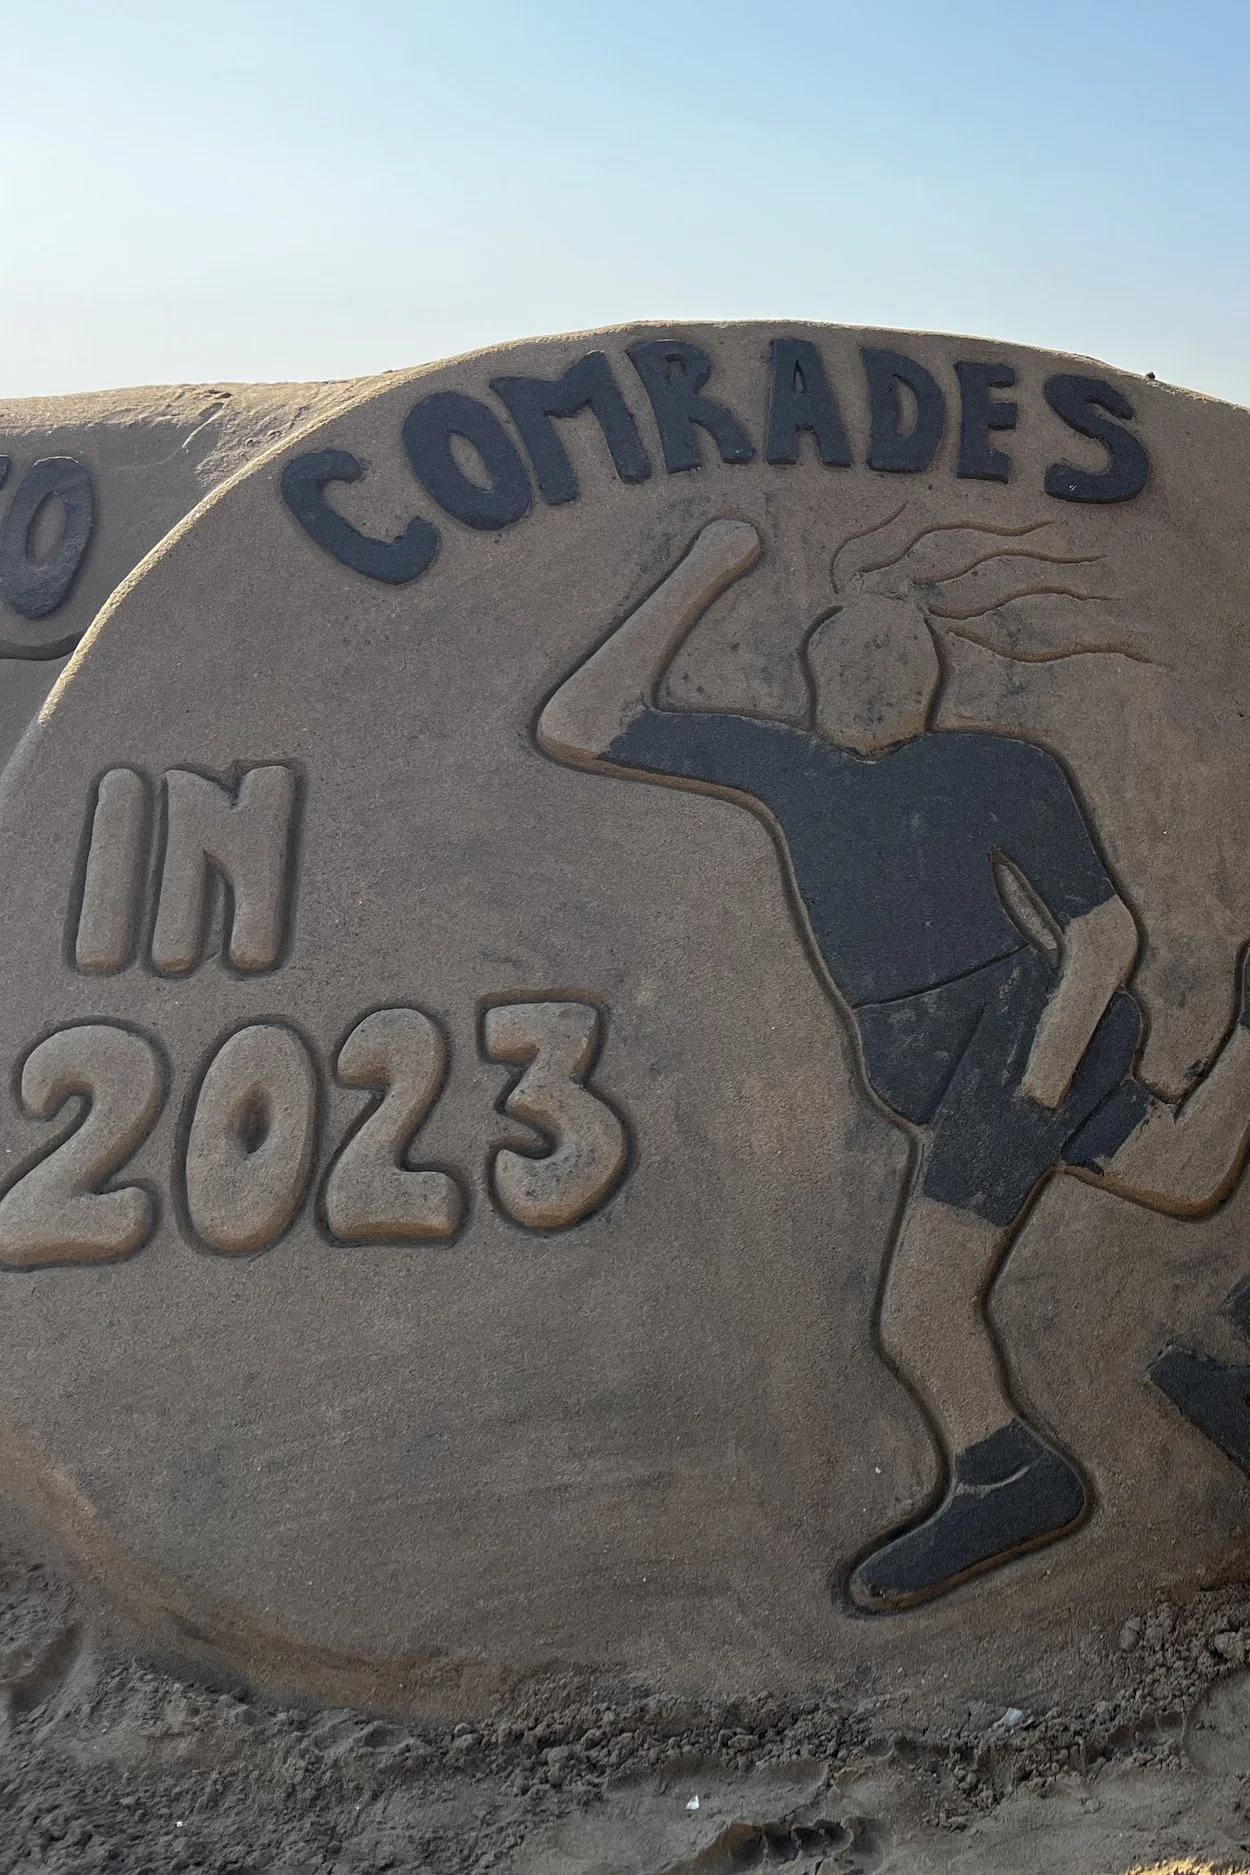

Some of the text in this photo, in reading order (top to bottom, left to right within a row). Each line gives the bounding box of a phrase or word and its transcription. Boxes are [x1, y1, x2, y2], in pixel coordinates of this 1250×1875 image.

[280, 338, 1150, 585] COMRADES
[75, 764, 297, 974] IN
[0, 1000, 629, 1269] 2023
